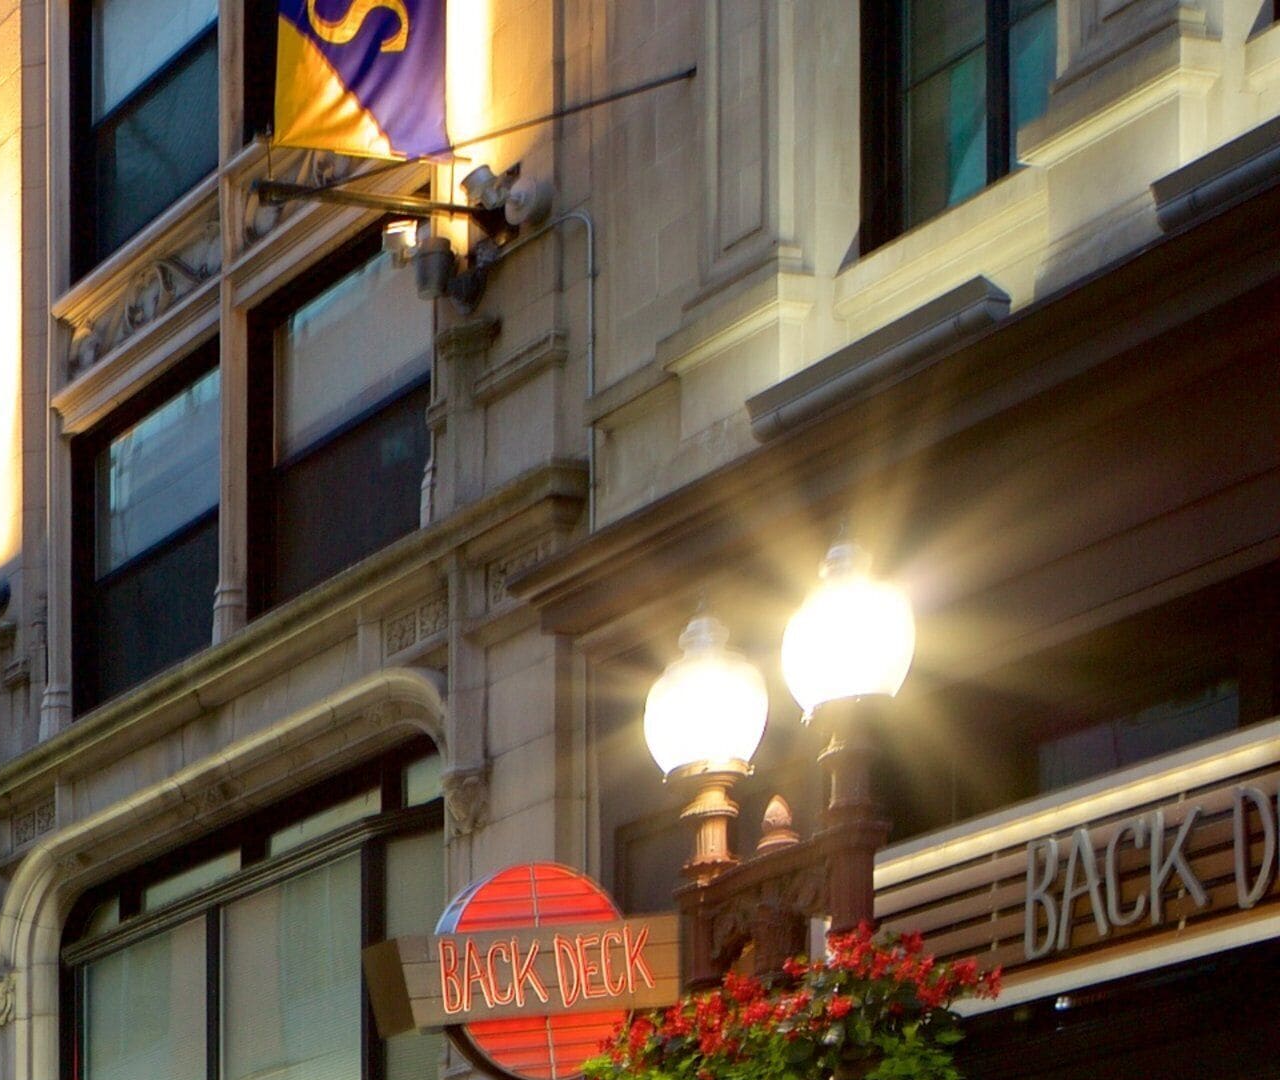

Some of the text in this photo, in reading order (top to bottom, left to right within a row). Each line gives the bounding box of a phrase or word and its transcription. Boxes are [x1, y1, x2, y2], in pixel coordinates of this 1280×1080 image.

[1024, 786, 1280, 961] BACK D
[439, 923, 656, 1014] BACK DECK
